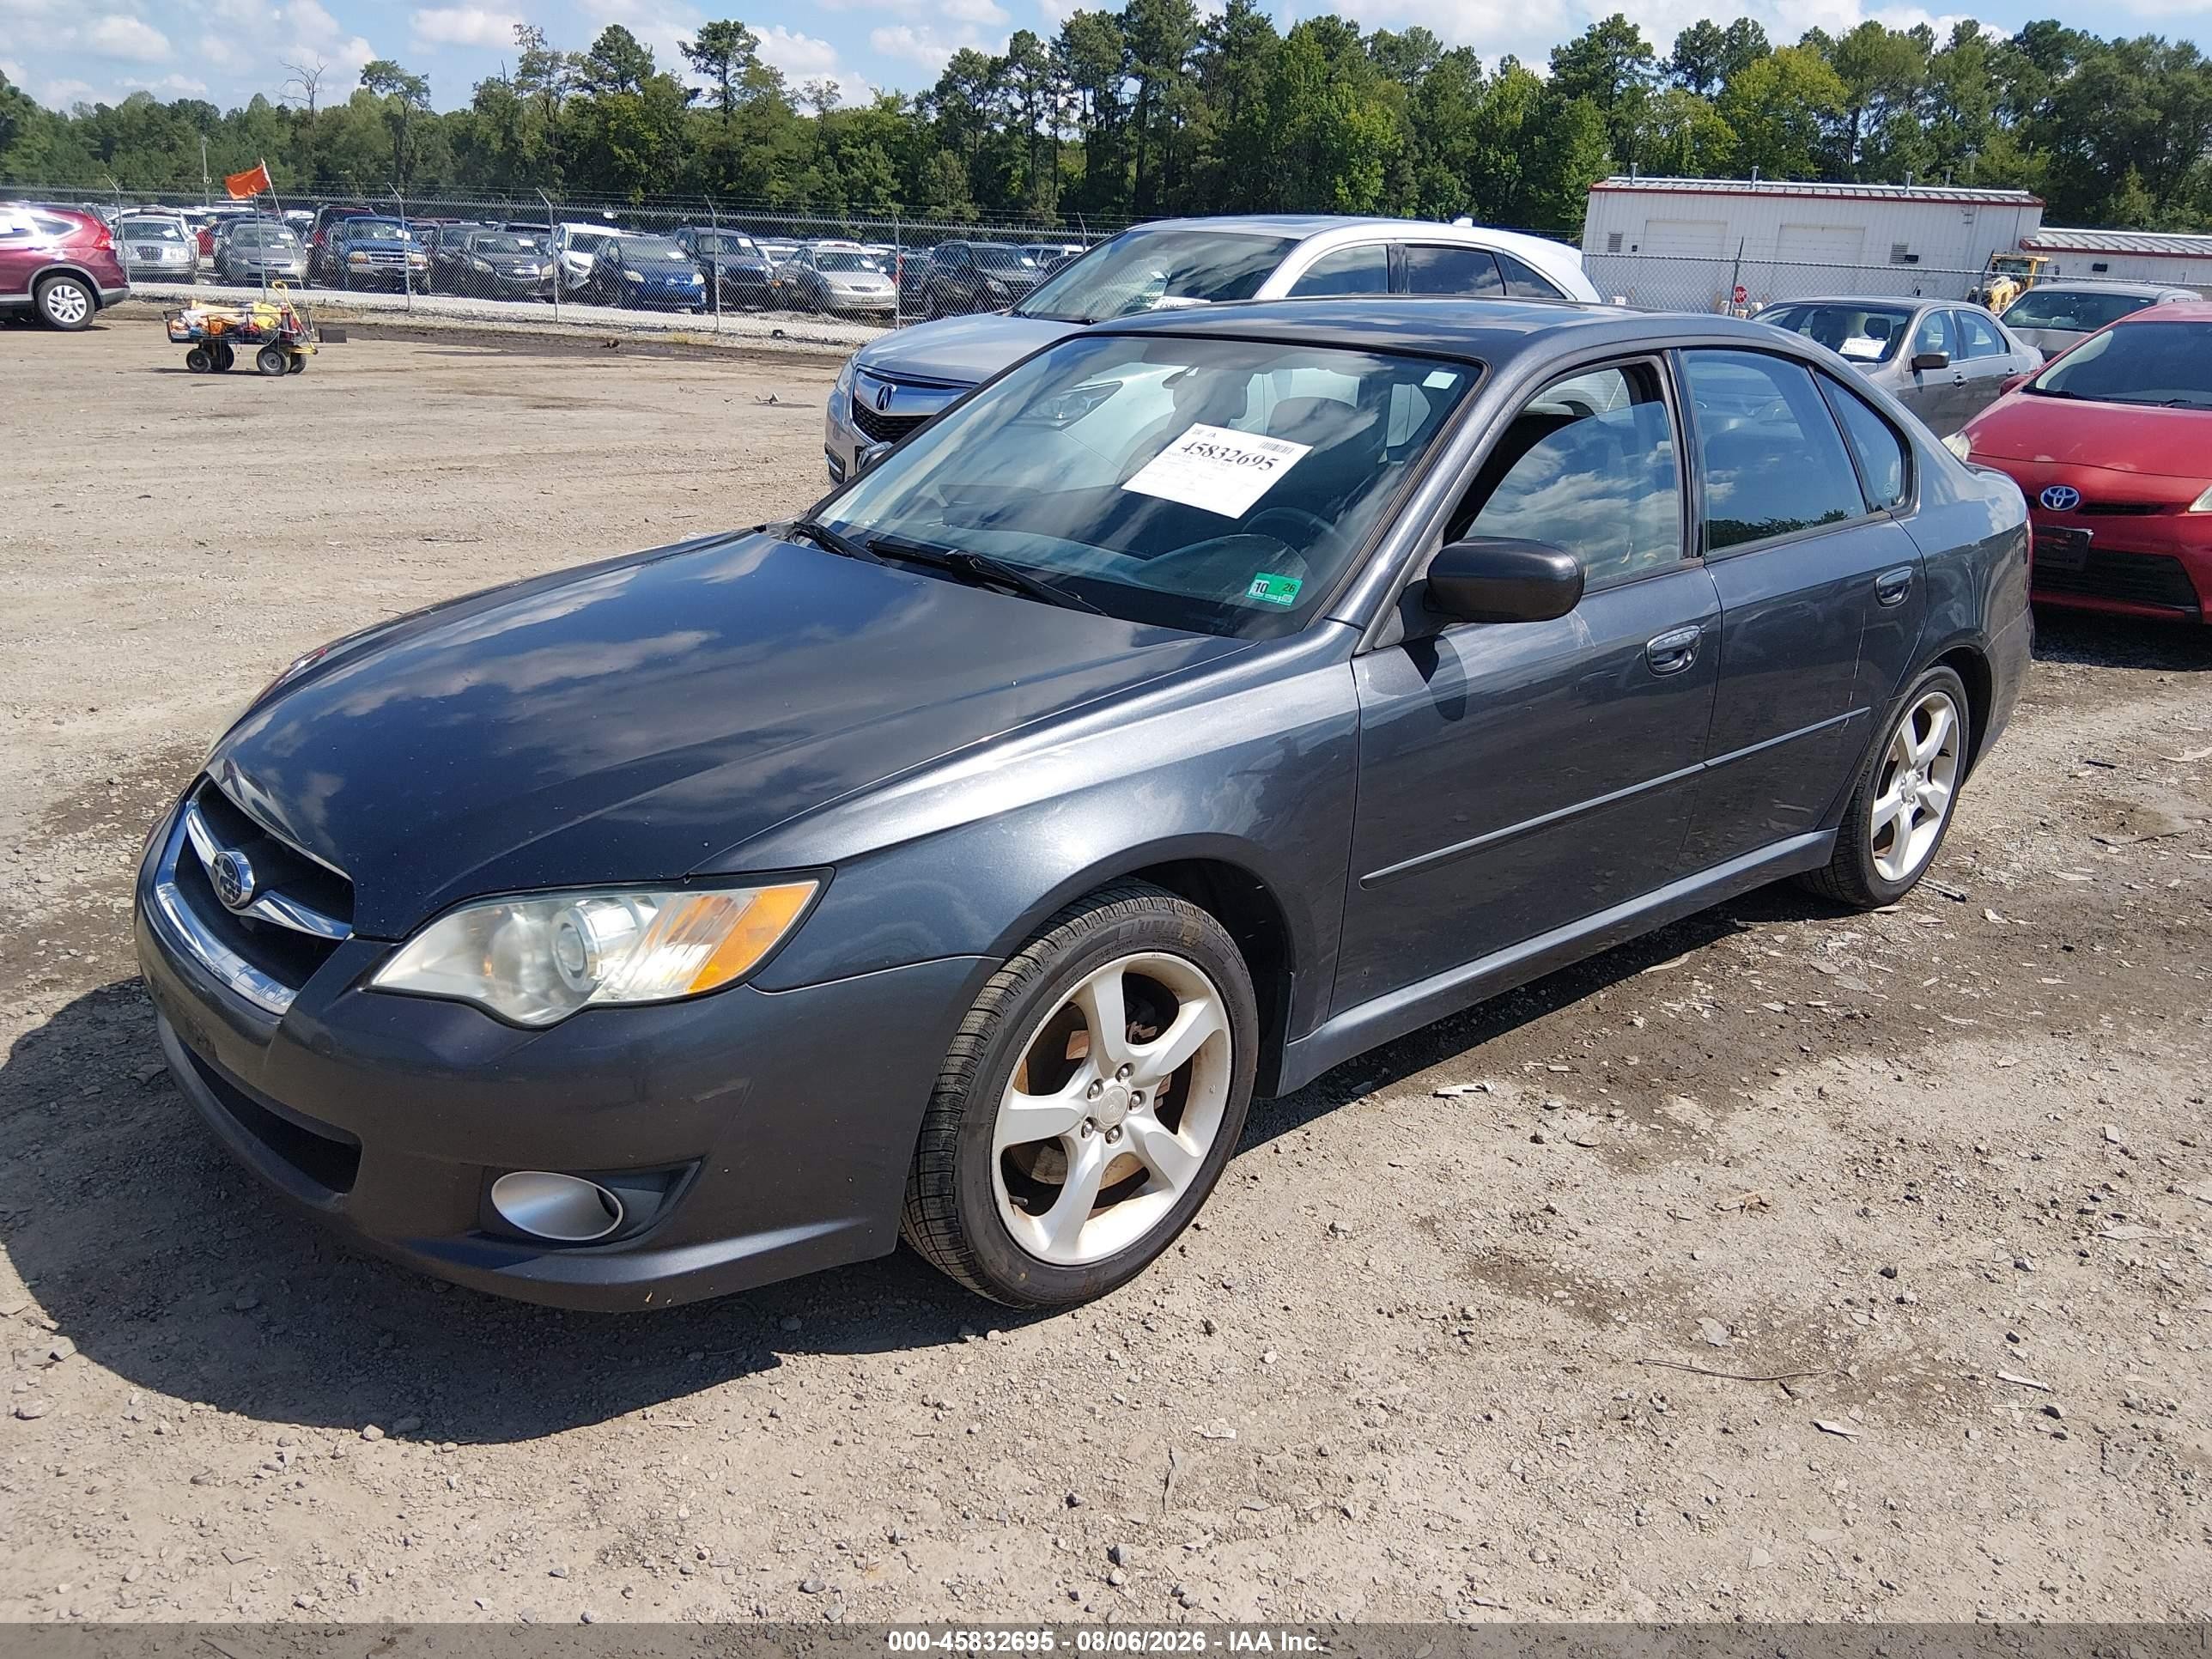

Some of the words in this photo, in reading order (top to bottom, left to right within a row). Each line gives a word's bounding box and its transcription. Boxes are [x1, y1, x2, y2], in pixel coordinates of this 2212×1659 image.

[1181, 441, 1280, 471] 45832695
[1255, 581, 1270, 594] 10
[1282, 582, 1297, 593] 26
